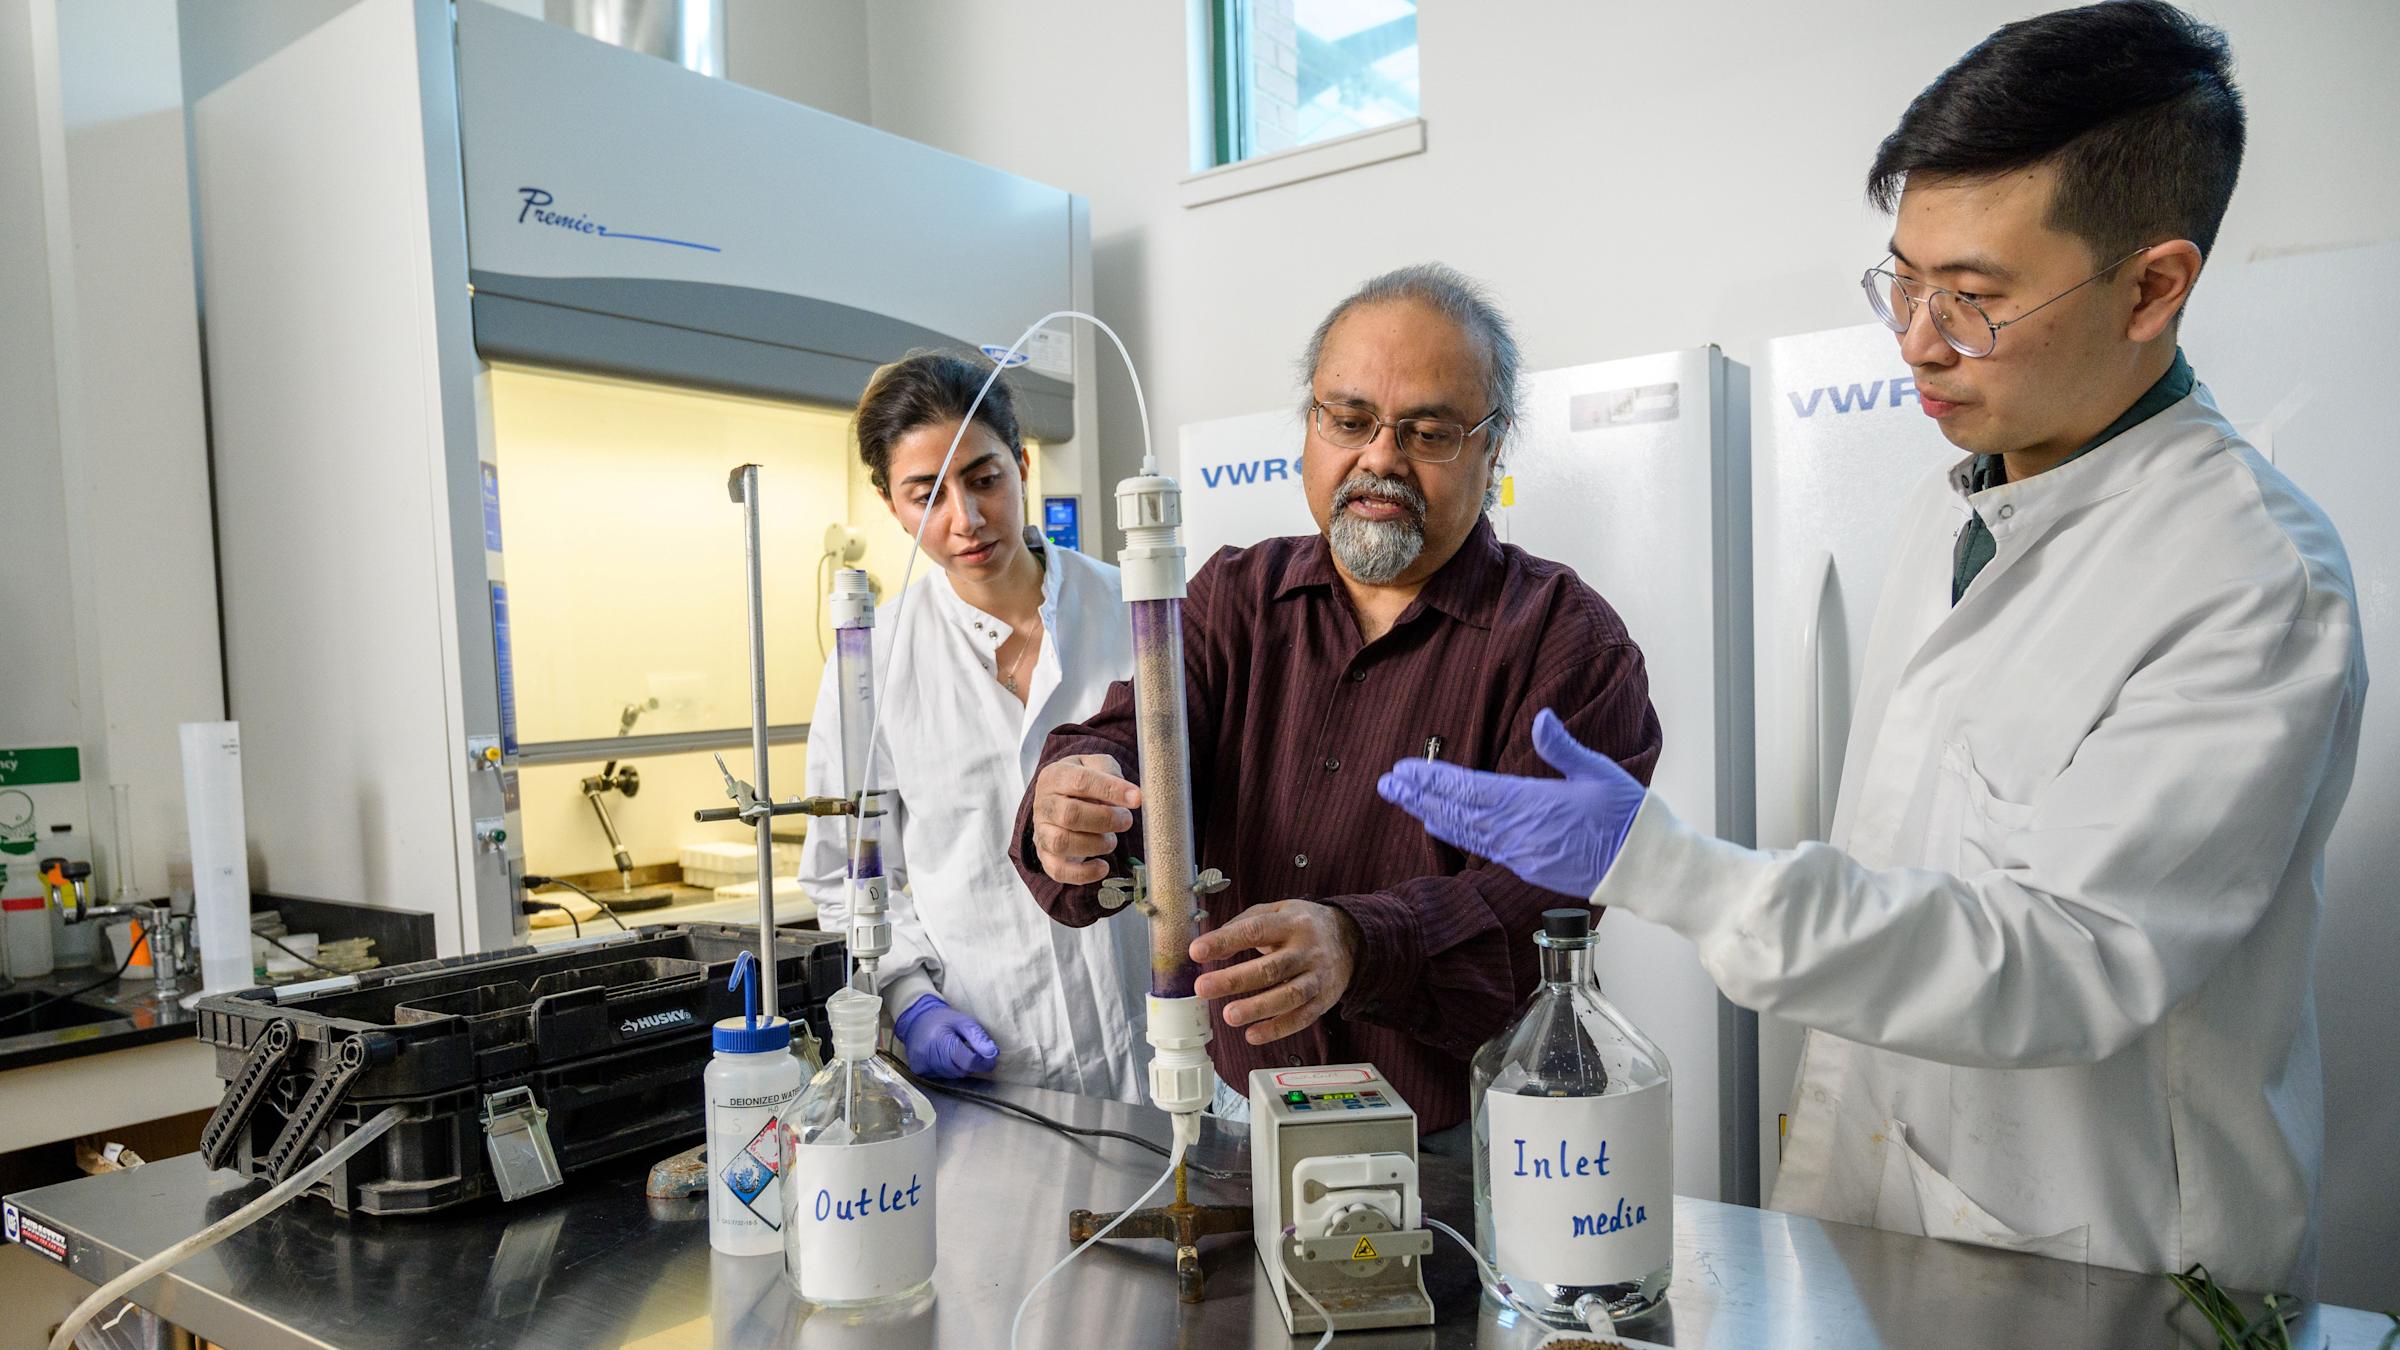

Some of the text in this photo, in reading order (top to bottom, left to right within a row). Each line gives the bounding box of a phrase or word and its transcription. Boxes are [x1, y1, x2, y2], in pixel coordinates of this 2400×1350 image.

[518, 181, 607, 237] Premier
[1786, 376, 1922, 419] VWR
[1200, 457, 1289, 489] VWR
[637, 1008, 686, 1029] HUSKY
[729, 1086, 801, 1106] DEIONIZED WATE
[1513, 1138, 1611, 1179] Inlet
[815, 1173, 922, 1222] Outlet
[1571, 1197, 1648, 1238] media
